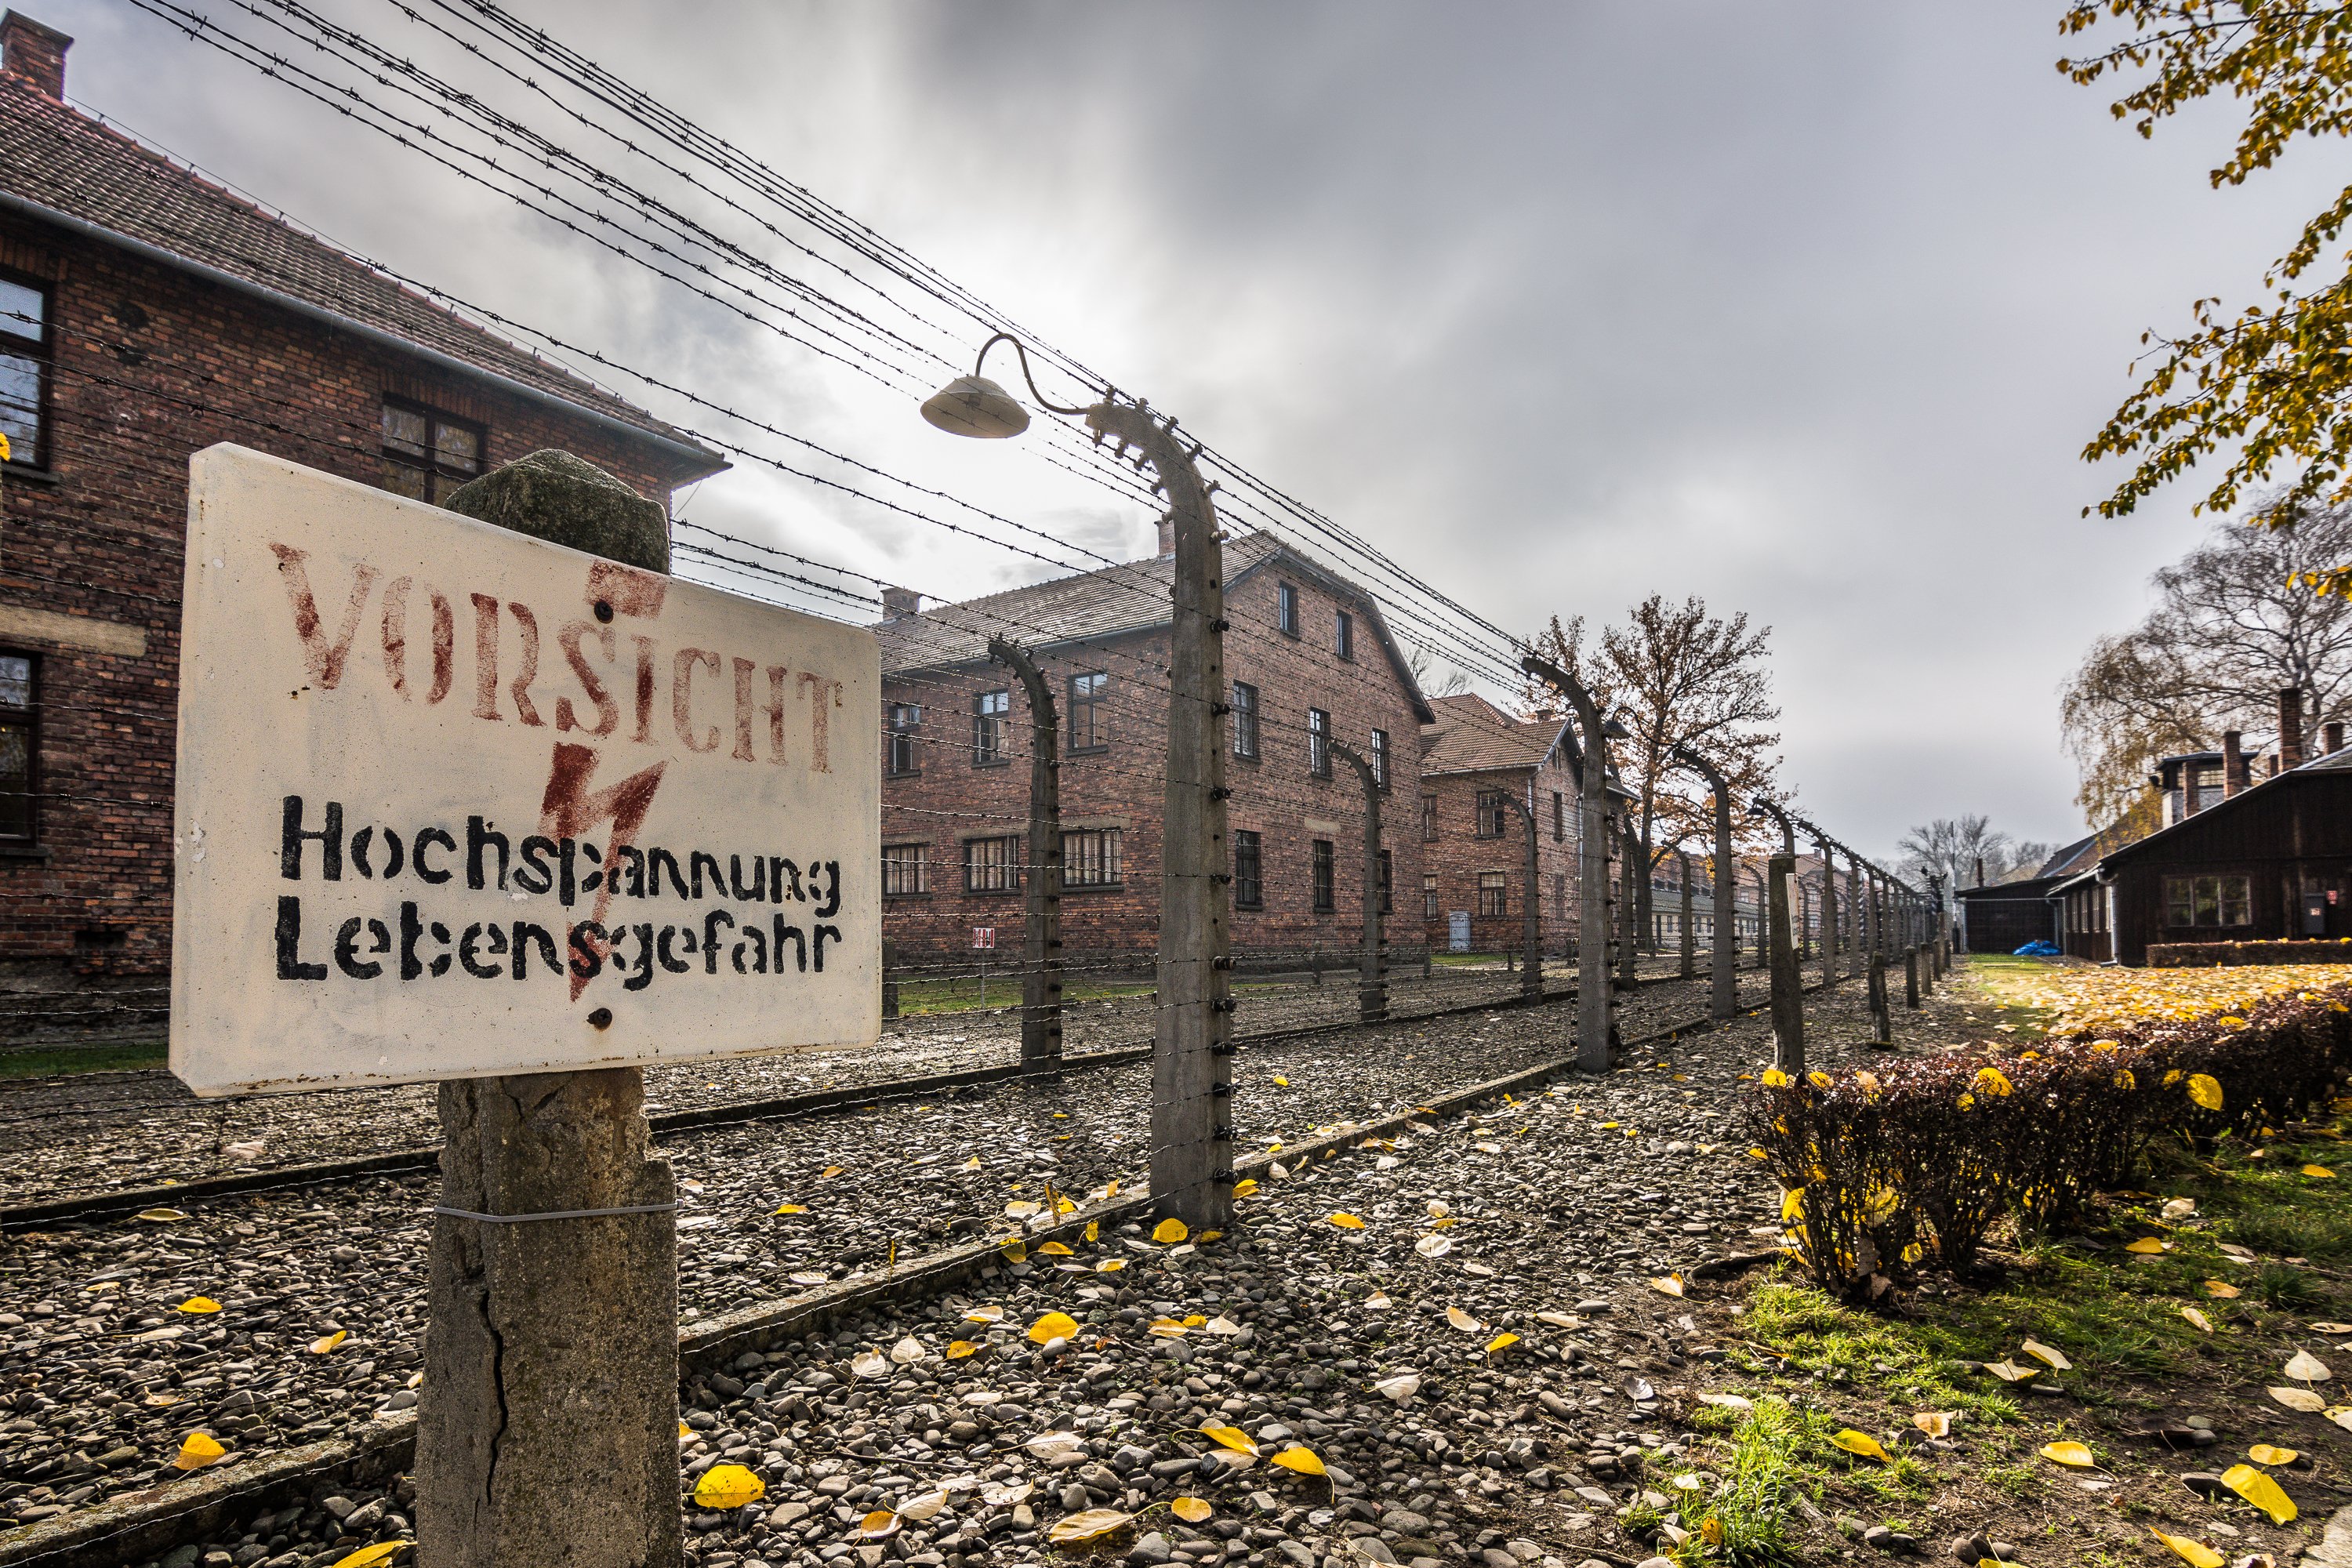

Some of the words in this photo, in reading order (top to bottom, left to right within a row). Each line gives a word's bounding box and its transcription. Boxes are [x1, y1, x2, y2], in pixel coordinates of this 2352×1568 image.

[269, 543, 844, 772] VORSICHT
[281, 795, 840, 917] Hochspannung
[274, 895, 842, 989] Lebensgefahr
